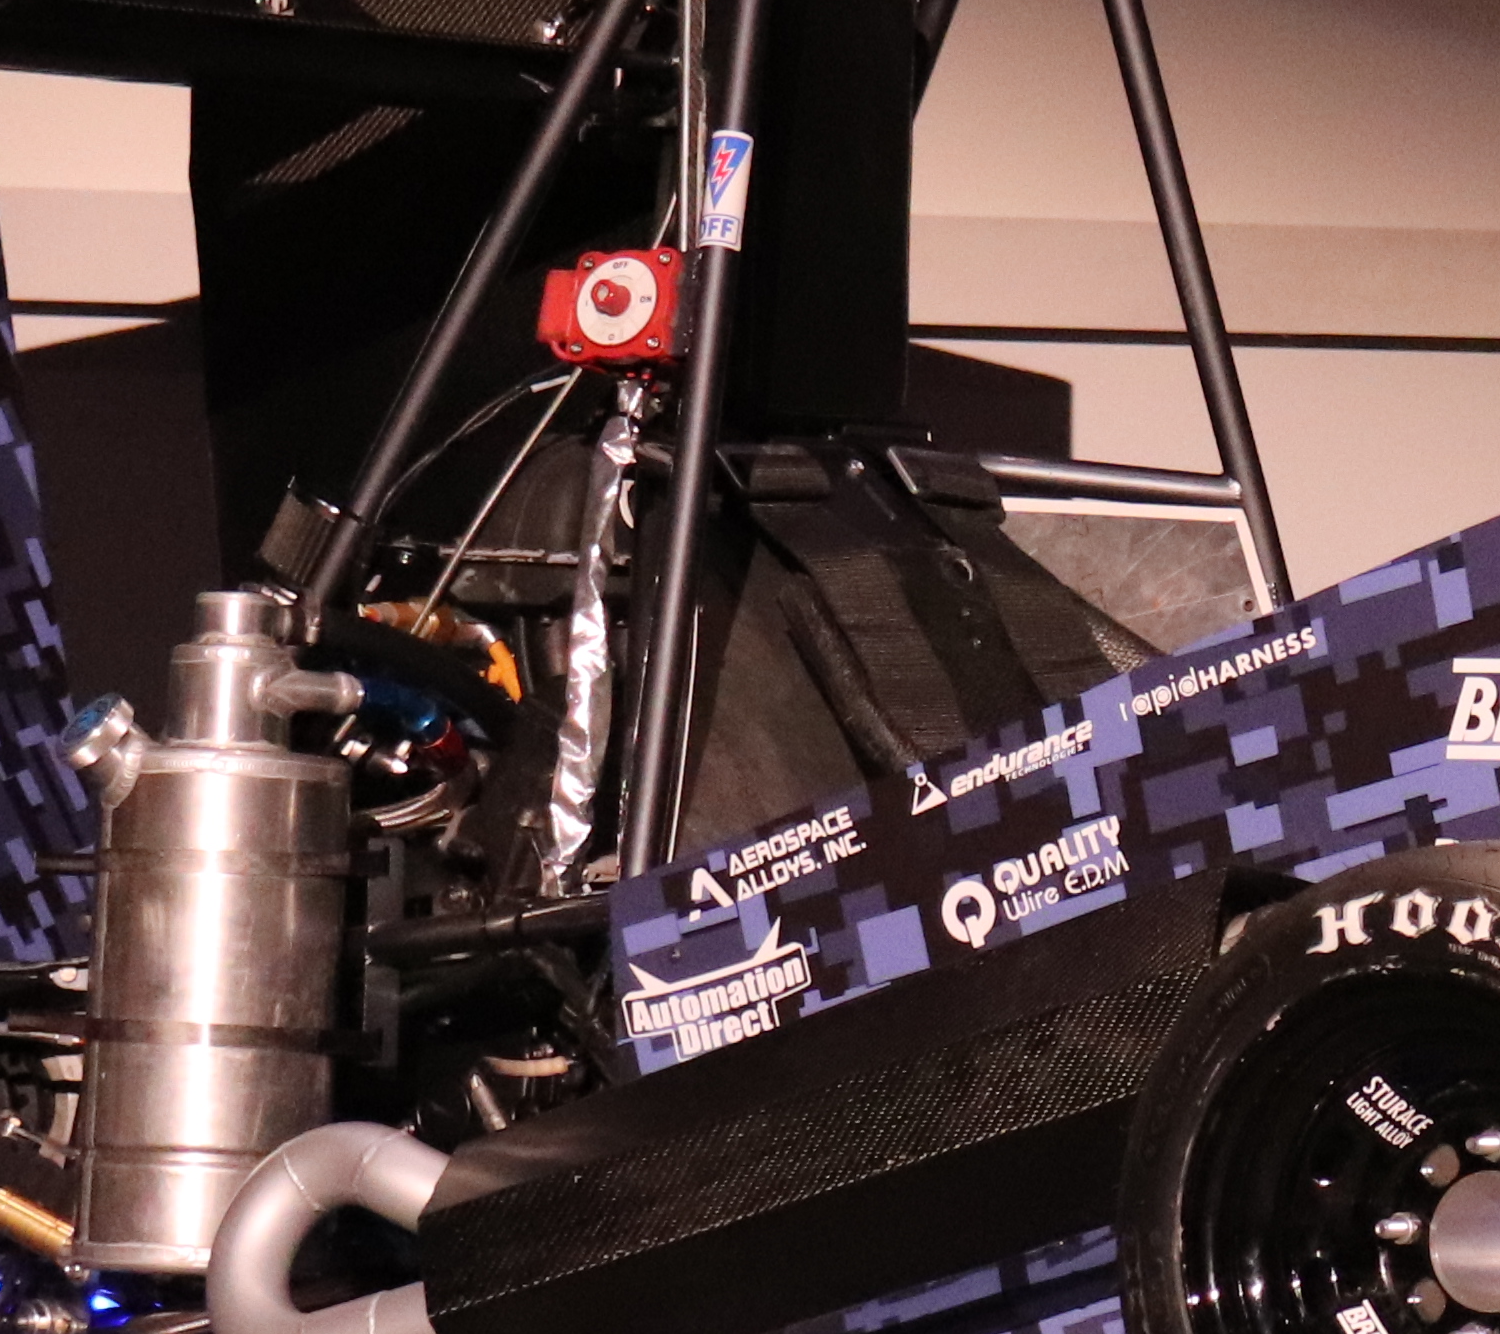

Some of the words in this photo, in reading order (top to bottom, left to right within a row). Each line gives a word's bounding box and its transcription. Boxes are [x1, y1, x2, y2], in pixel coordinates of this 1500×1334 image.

[612, 260, 629, 270] OFF
[639, 295, 652, 303] ON
[950, 719, 1093, 798] endurance
[1004, 742, 1085, 783] TECHNOLOGIES
[729, 805, 853, 877] AEROSPACE
[737, 849, 823, 902] ALLOYS,
[823, 831, 867, 866] INC.
[993, 815, 1121, 896] QUALITY
[1002, 886, 1061, 922] Wire
[631, 955, 805, 1035] Automation
[676, 998, 776, 1058] Direct
[1346, 1091, 1383, 1127] LIGHT
[1374, 1120, 1414, 1149] ALLOY
[1362, 1075, 1434, 1136] STURACE
